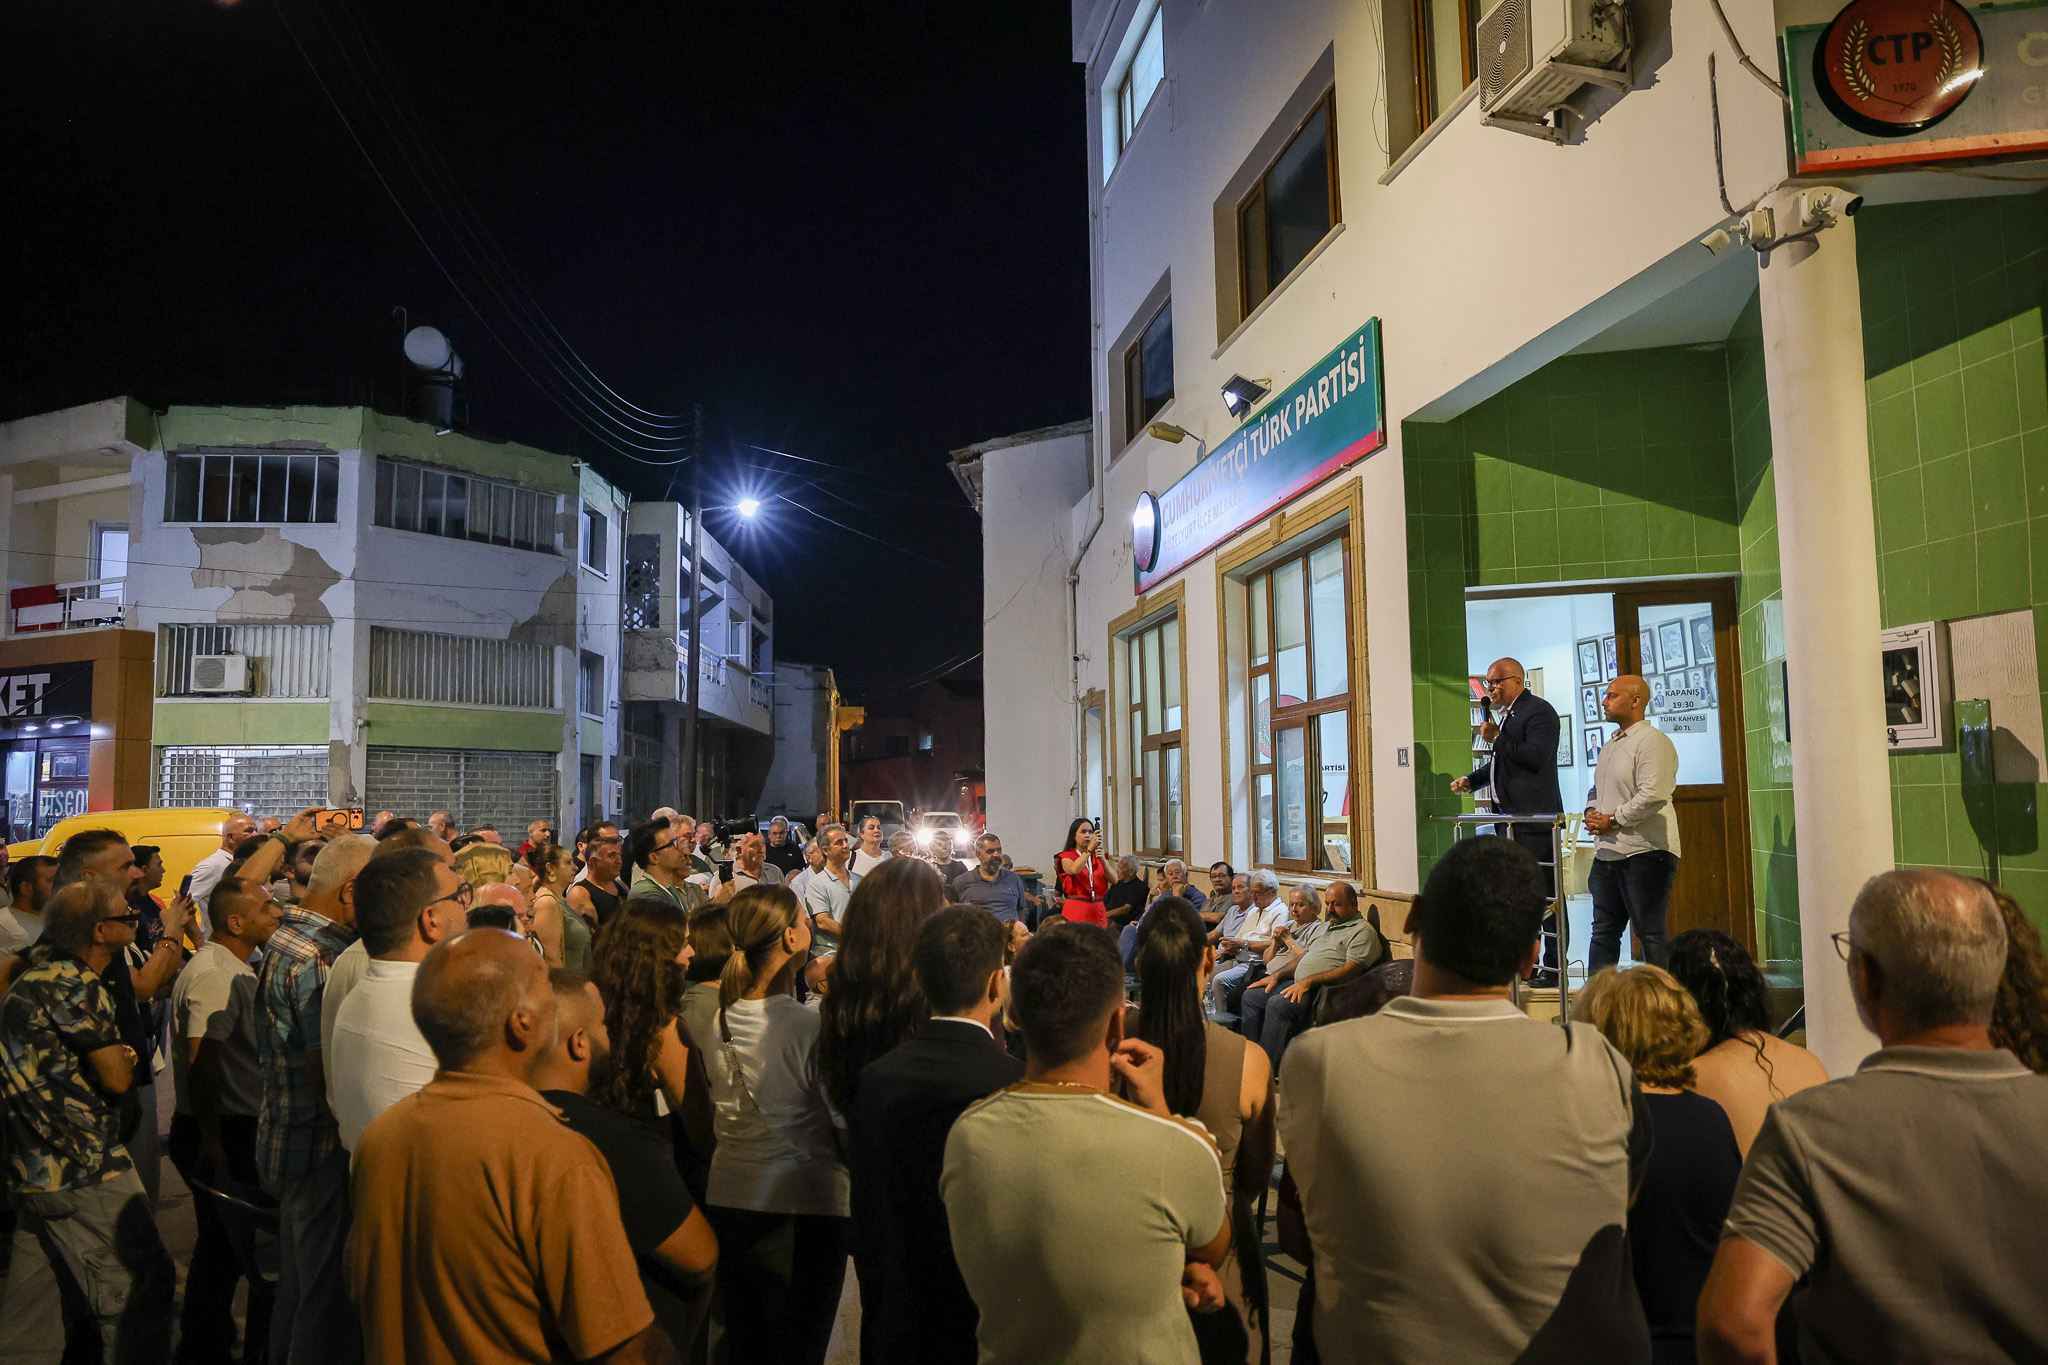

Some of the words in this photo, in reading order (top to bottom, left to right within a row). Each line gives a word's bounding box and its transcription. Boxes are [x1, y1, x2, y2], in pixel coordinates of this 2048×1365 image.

[1867, 31, 1933, 67] CTP
[1893, 82, 1917, 93] 1970
[1162, 430, 1248, 529] CUMHURİYETÇİ
[1250, 403, 1293, 463] TÜRK
[1296, 335, 1366, 431] PARTİSİ
[1665, 689, 1700, 697] KAPANIŞ
[1673, 701, 1694, 709] 19:30
